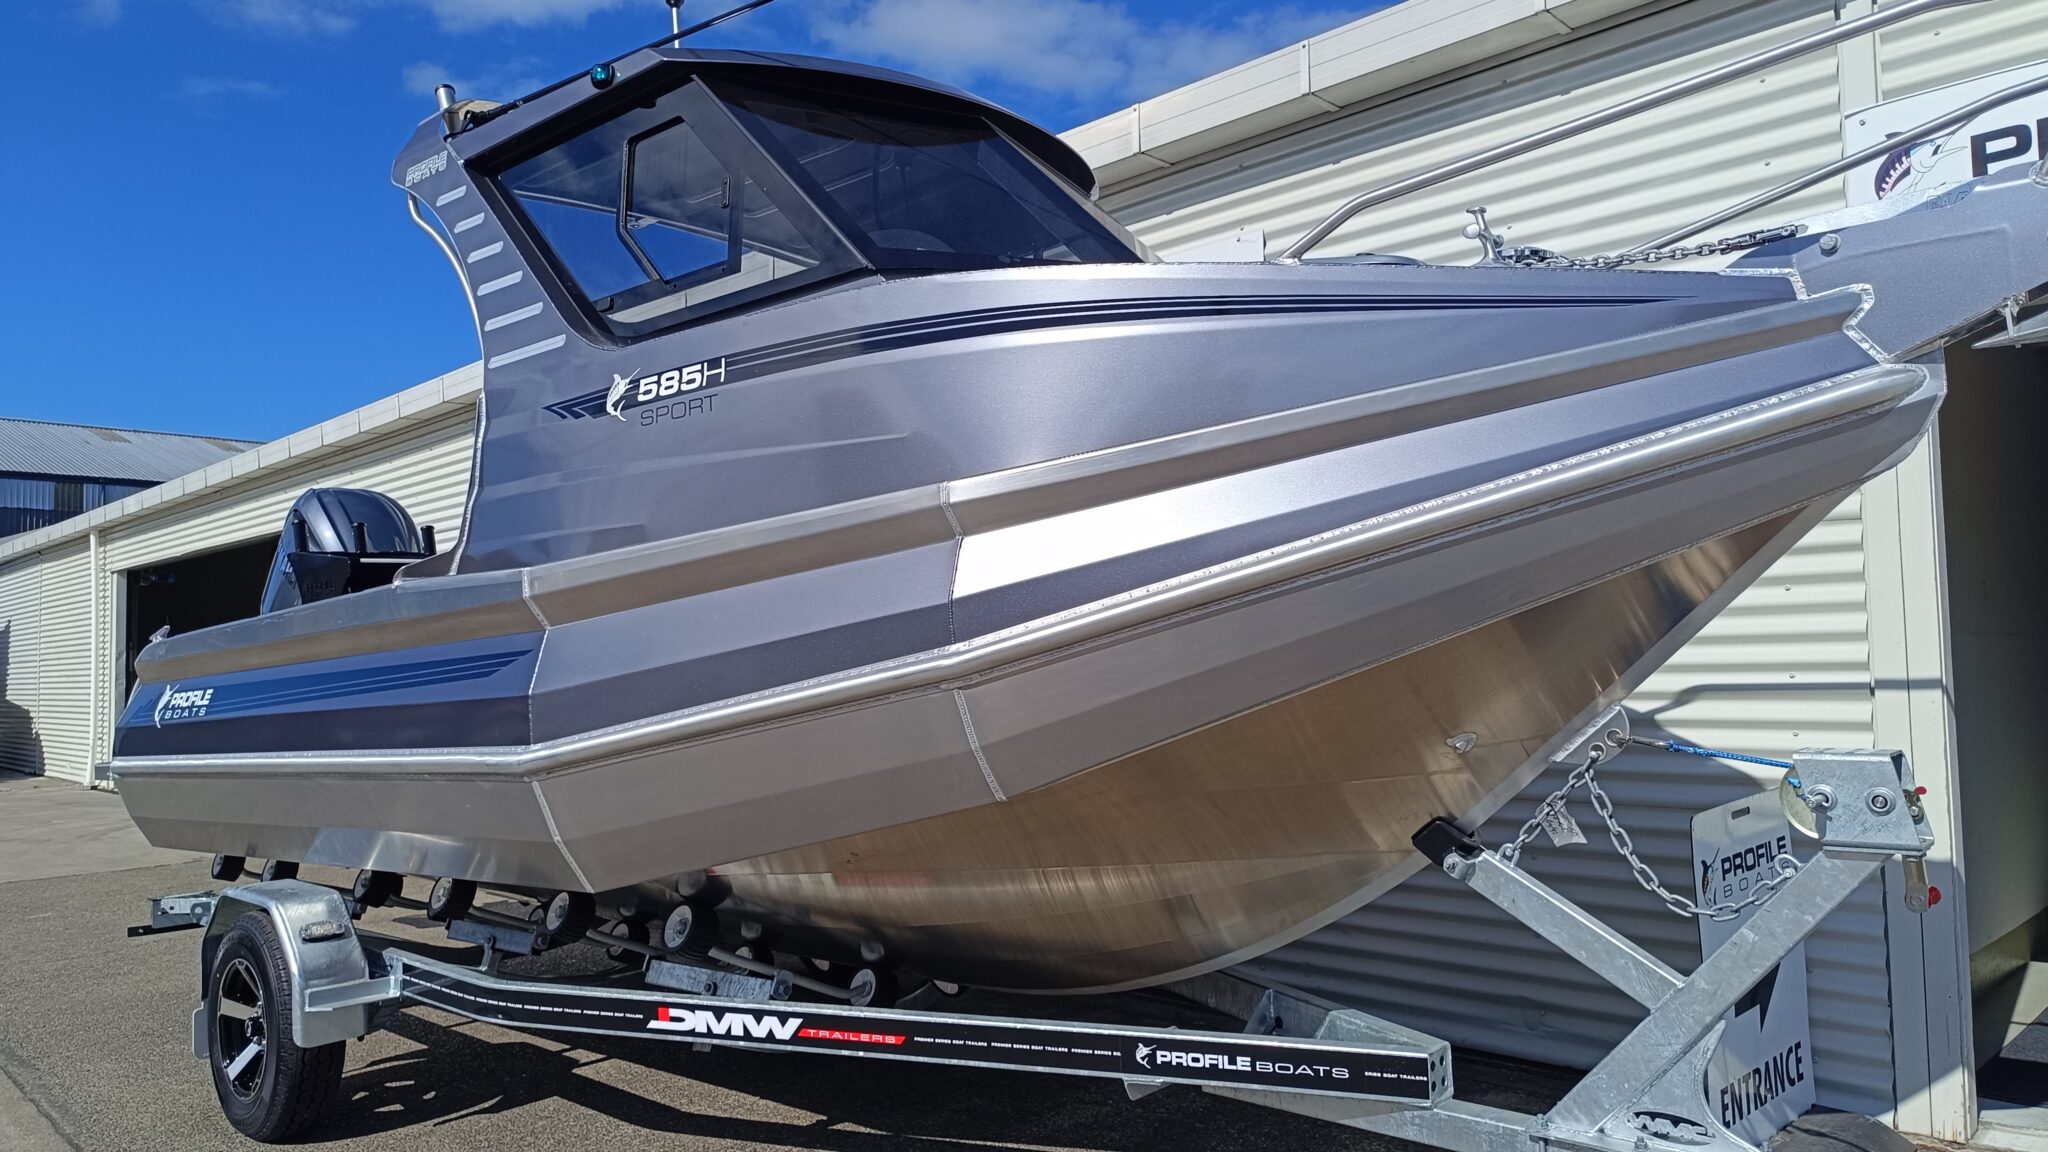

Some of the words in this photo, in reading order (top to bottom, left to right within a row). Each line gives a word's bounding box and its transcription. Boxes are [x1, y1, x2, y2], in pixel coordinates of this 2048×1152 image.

[637, 357, 725, 402] 585H
[640, 393, 719, 427] SPORT
[164, 706, 207, 719] BOATS
[168, 688, 214, 709] PROFILE
[1720, 835, 1788, 881] PROFILE
[646, 1007, 803, 1041] DMW
[807, 1029, 897, 1044] TRAILERS
[1156, 1050, 1251, 1072] PROFILE
[1255, 1061, 1349, 1079] BOATS
[1720, 1040, 1804, 1130] ENTRANCE
